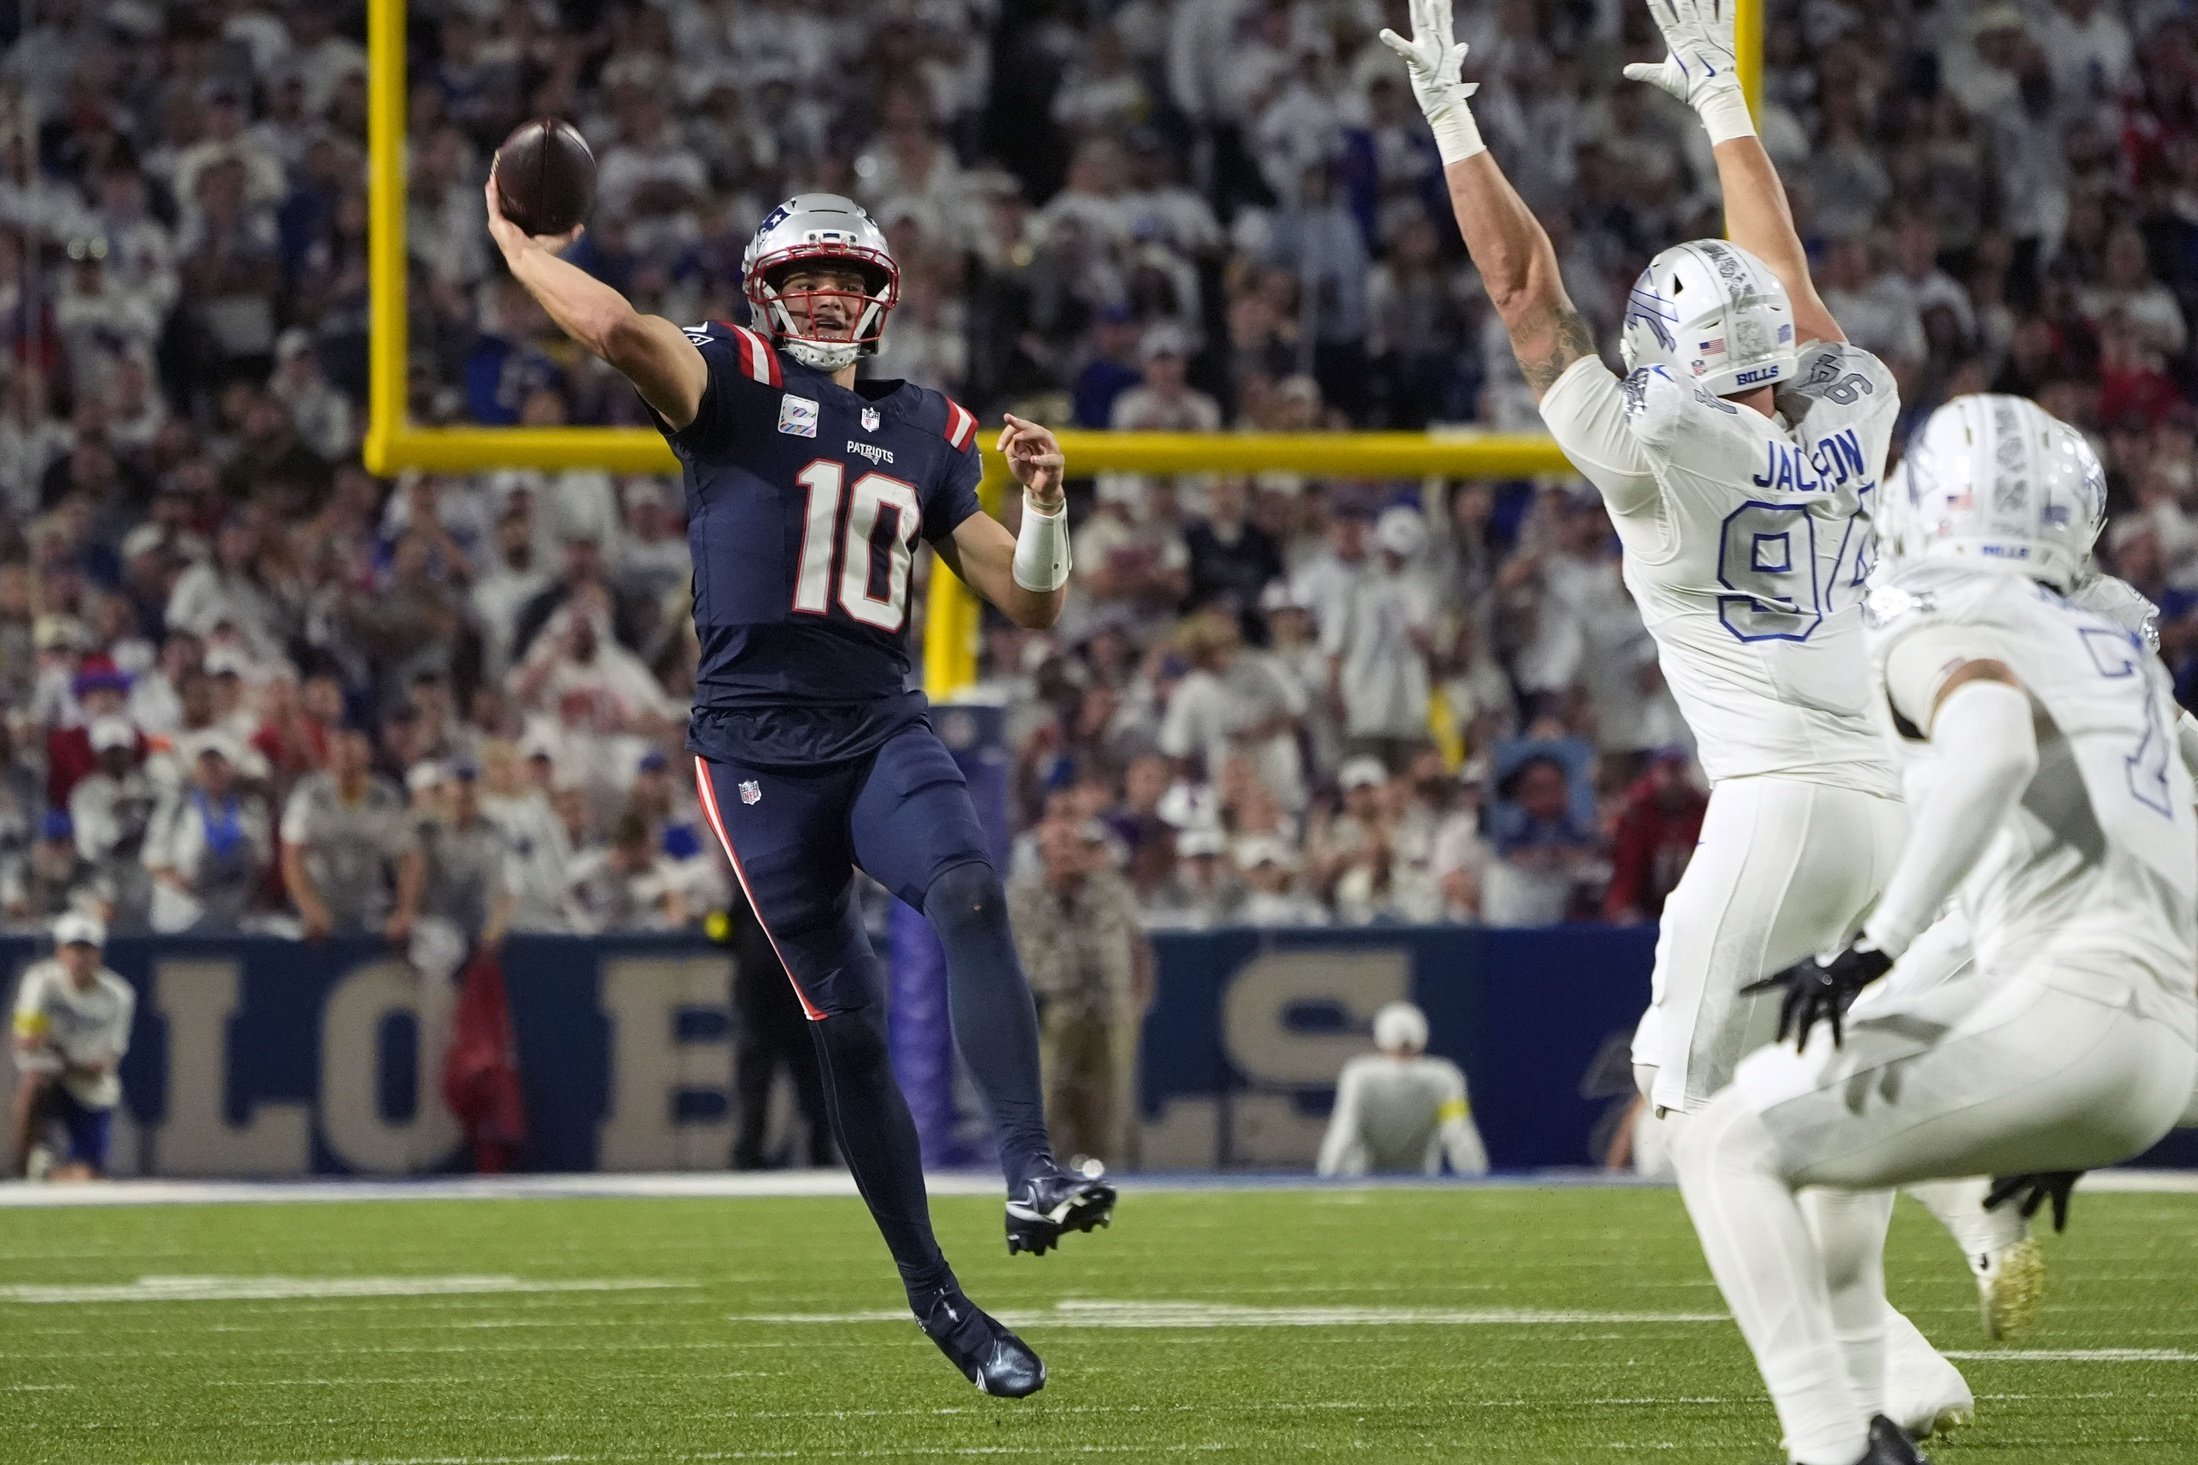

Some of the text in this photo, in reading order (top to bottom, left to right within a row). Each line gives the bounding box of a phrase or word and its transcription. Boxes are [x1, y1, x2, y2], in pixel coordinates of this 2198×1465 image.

[1736, 365, 1779, 386] BILLS
[846, 440, 894, 464] PATRIOTS
[792, 457, 921, 634] 10
